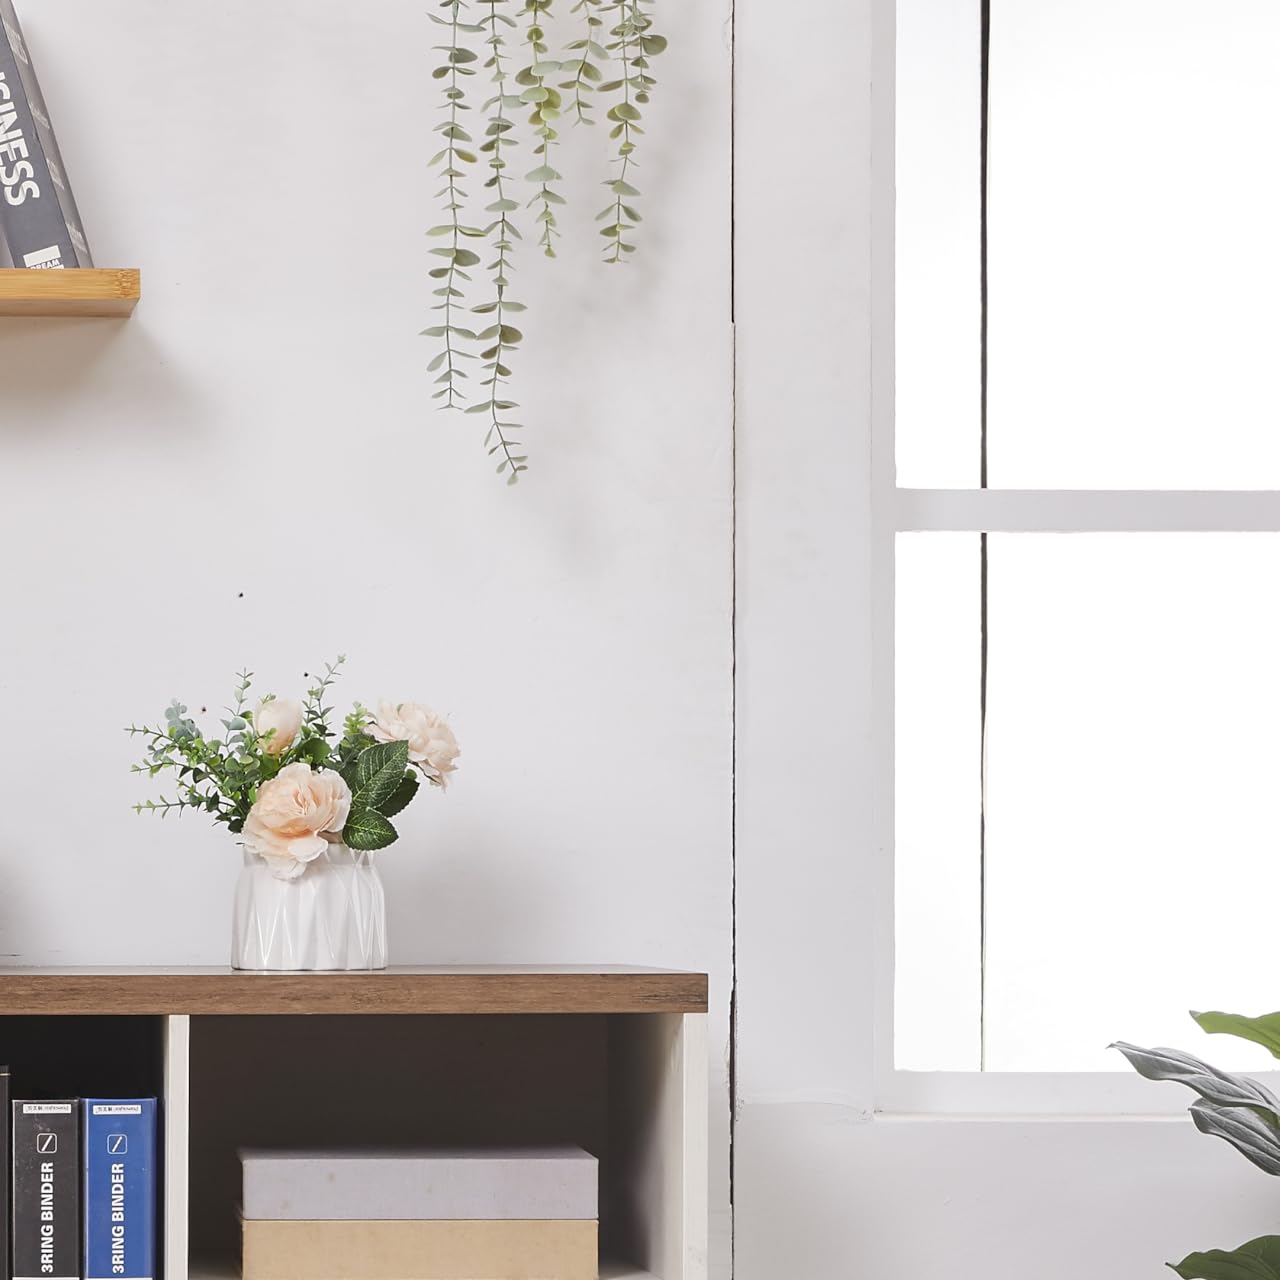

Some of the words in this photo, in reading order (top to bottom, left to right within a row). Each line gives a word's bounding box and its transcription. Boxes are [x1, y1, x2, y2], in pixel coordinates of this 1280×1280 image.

[40, 1162, 54, 1222] BINDER
[111, 1163, 125, 1222] BINDER
[40, 1224, 54, 1273] 3RING
[111, 1225, 125, 1274] 3RING
